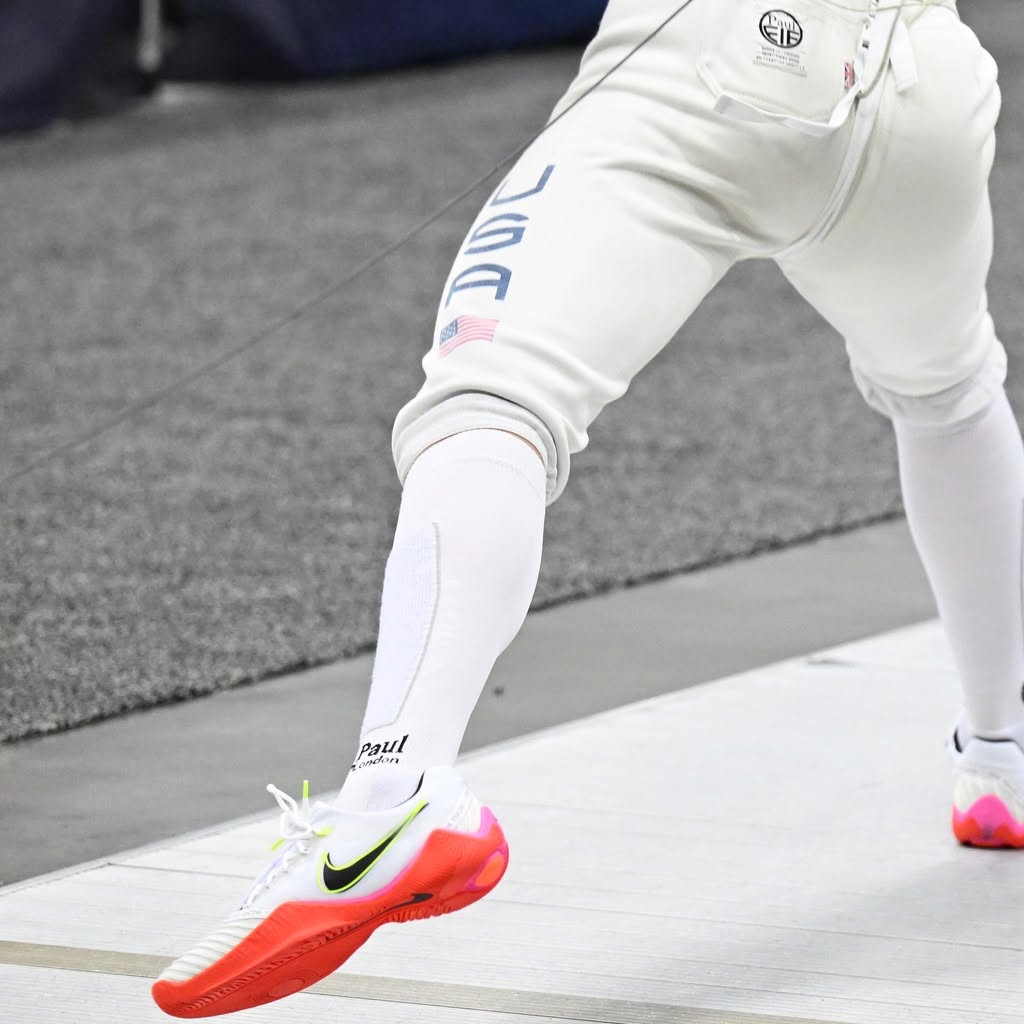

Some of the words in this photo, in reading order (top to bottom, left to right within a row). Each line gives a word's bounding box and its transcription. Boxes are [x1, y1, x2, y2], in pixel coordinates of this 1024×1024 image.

[445, 164, 556, 310] USA
[358, 734, 409, 761] Paul
[351, 755, 399, 772] ondon
